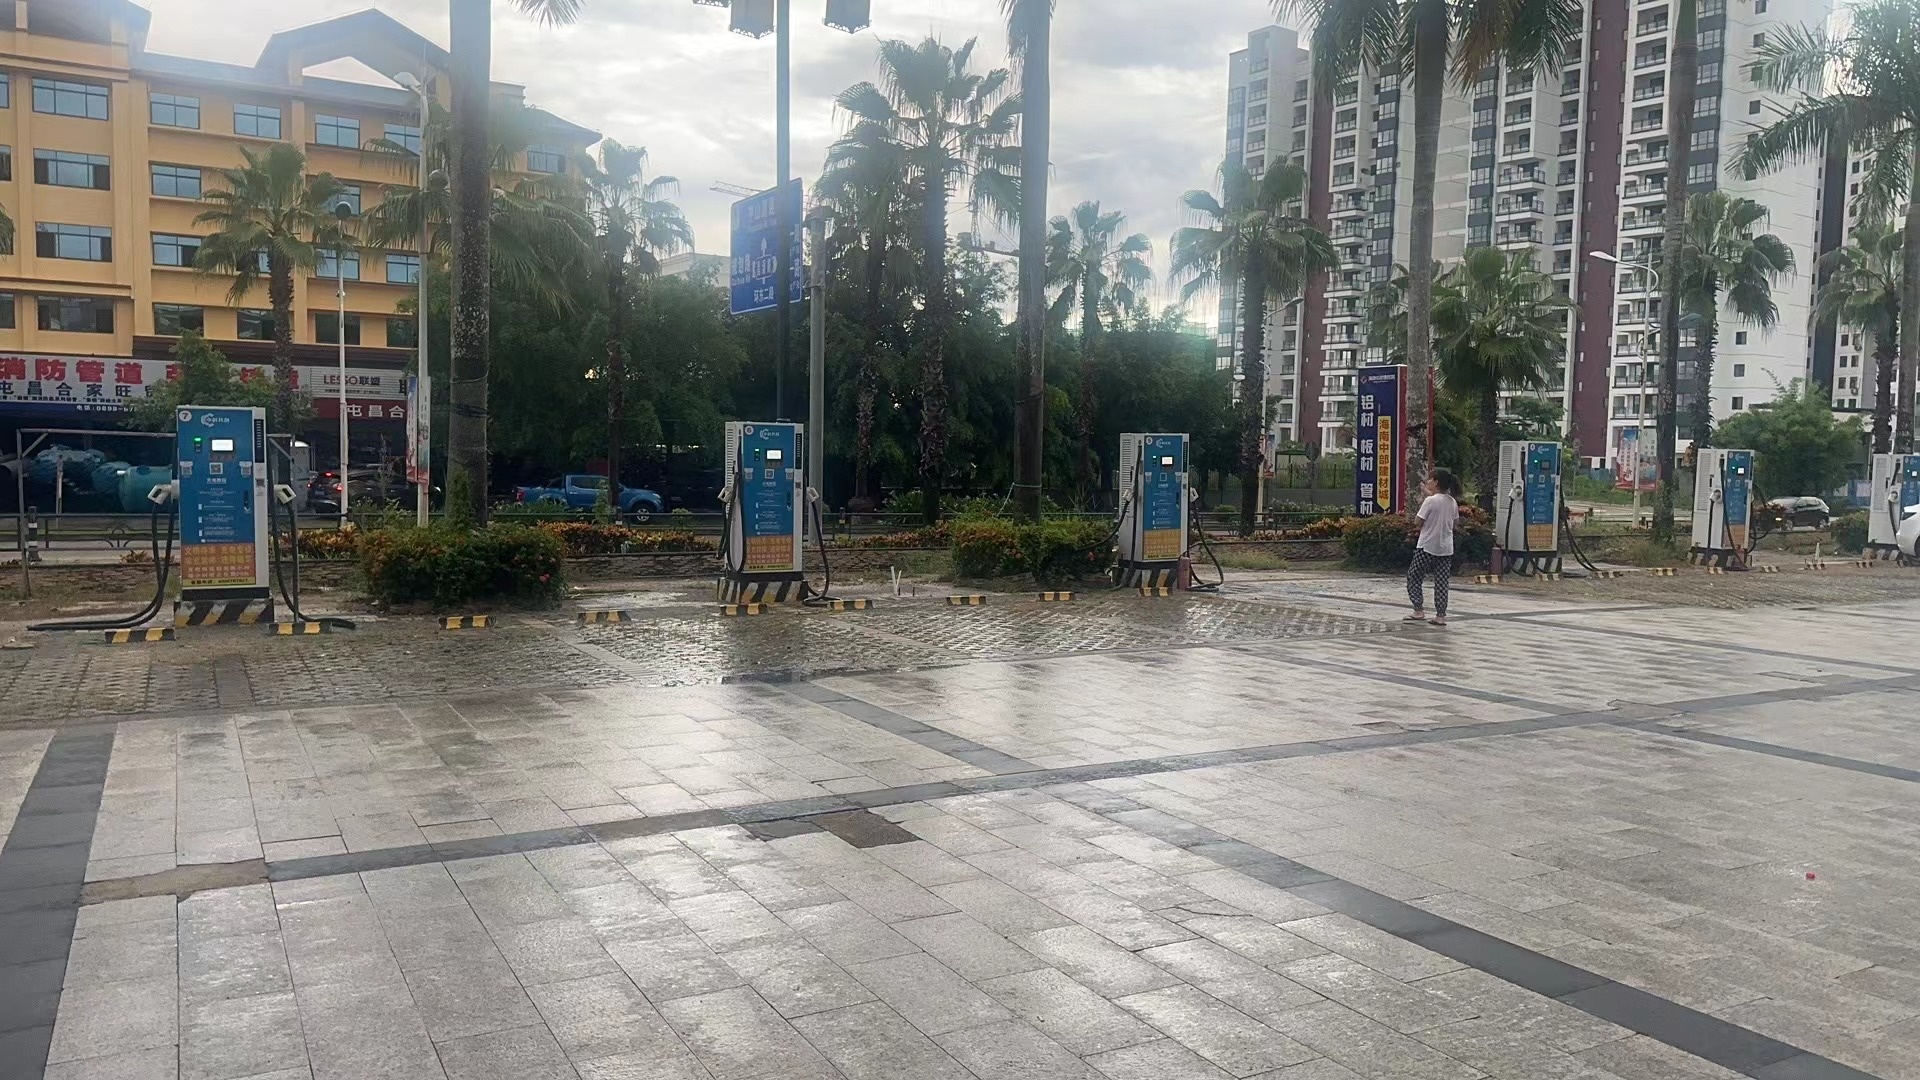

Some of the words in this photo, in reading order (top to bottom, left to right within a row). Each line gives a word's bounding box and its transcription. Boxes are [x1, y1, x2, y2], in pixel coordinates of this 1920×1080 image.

[1361, 394, 1374, 427] 铝材
[1361, 439, 1373, 472] 板材
[1379, 419, 1390, 500] 海南中部建材城
